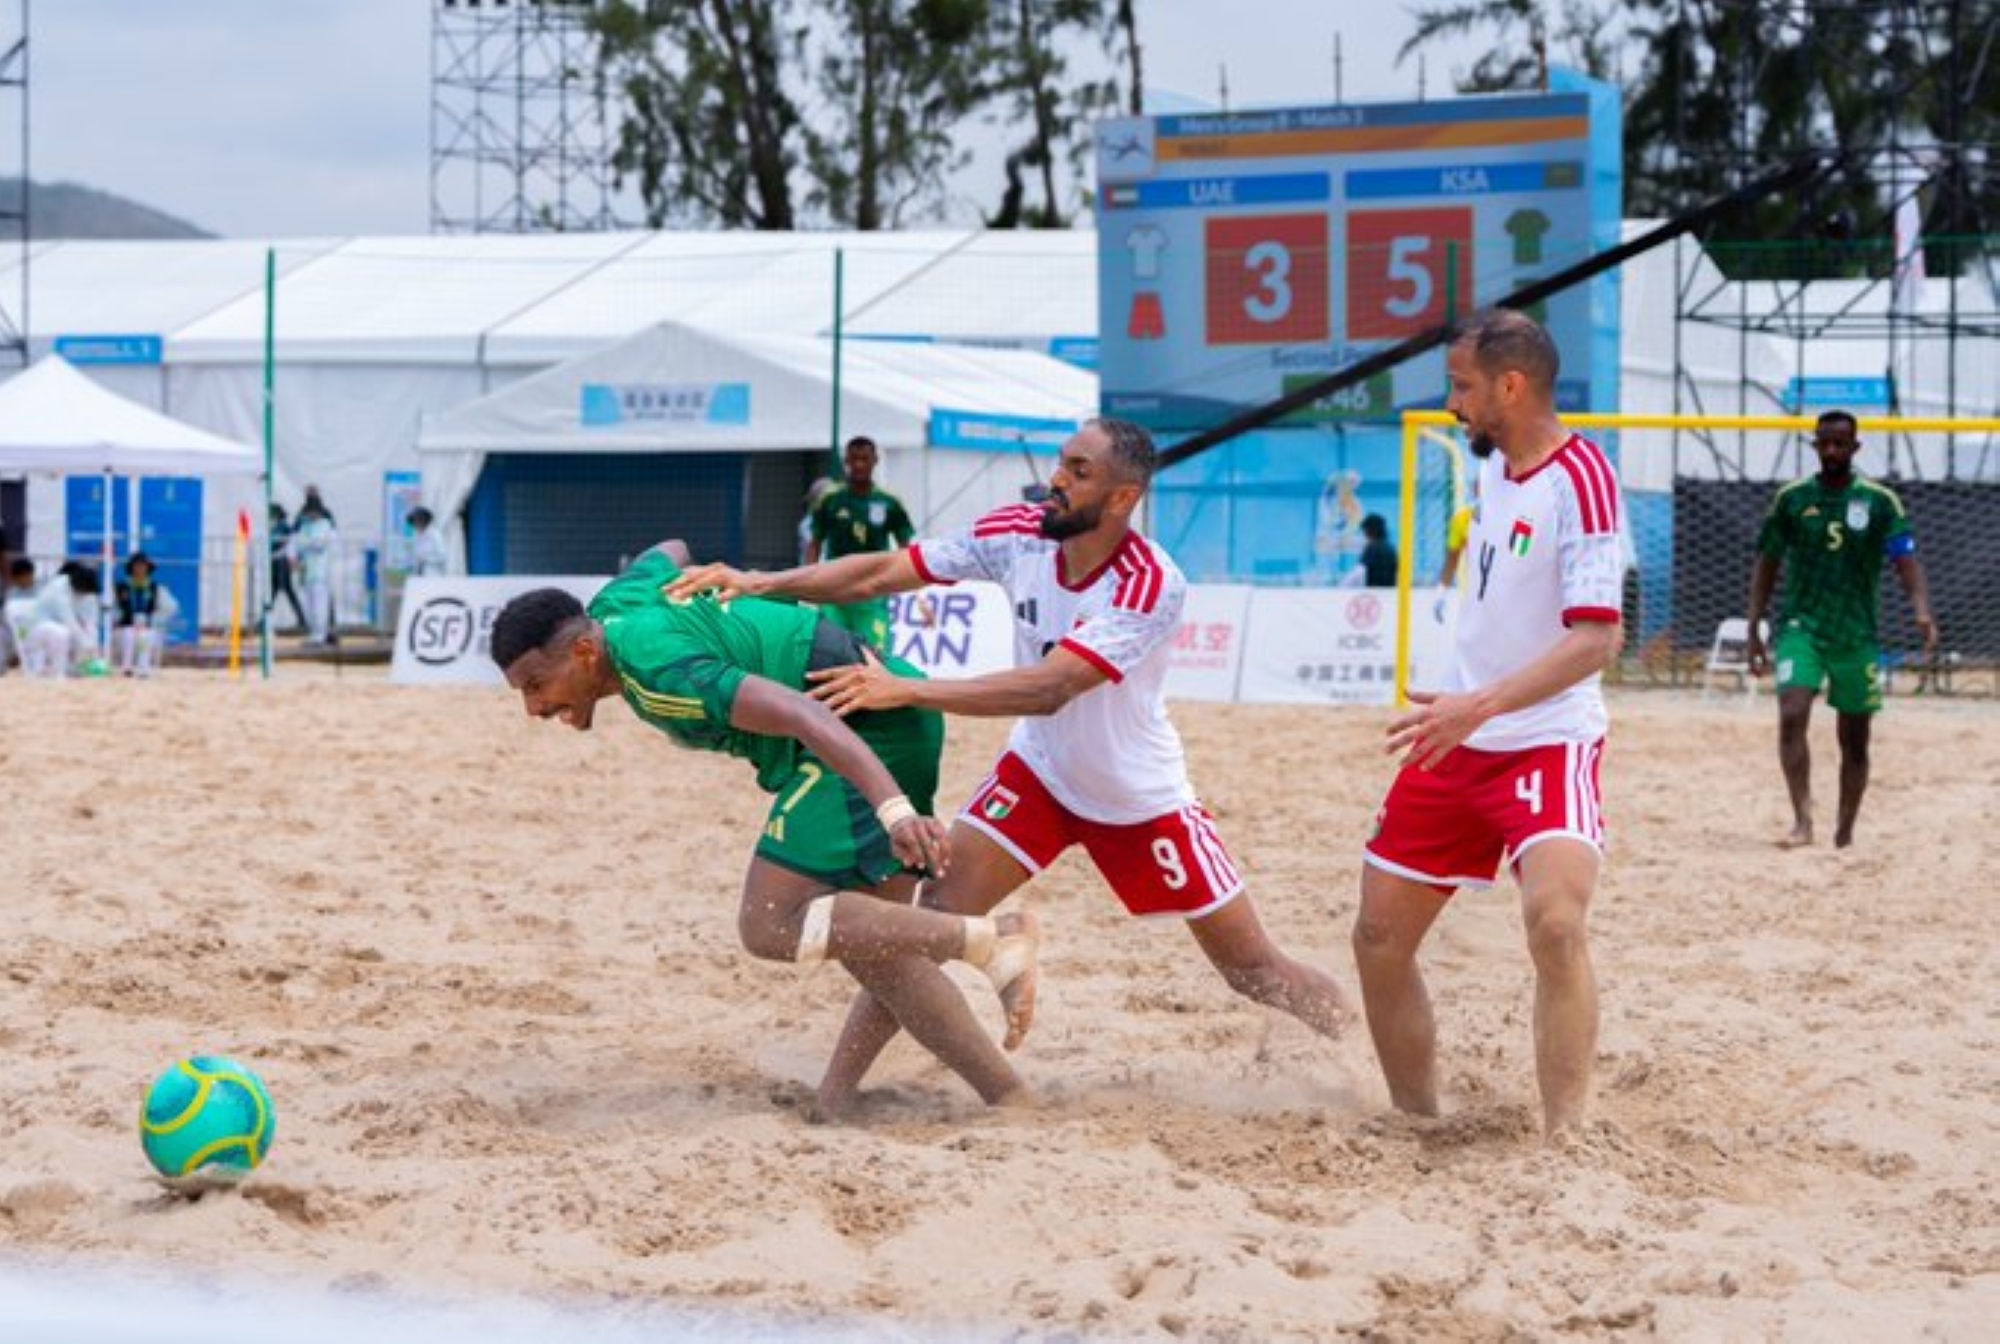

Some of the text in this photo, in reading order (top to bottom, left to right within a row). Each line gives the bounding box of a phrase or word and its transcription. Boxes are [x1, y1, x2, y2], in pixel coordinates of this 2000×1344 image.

[1189, 180, 1234, 202] UAE
[1440, 168, 1490, 191] KSA
[1244, 240, 1292, 323] 3
[1385, 235, 1433, 318] 5
[1827, 521, 1844, 550] 5
[419, 614, 462, 649] SF
[887, 632, 972, 665] AN
[1338, 634, 1383, 650] ICBC
[781, 762, 822, 813] 7
[1515, 769, 1543, 815] 4
[1152, 837, 1188, 890] 9
